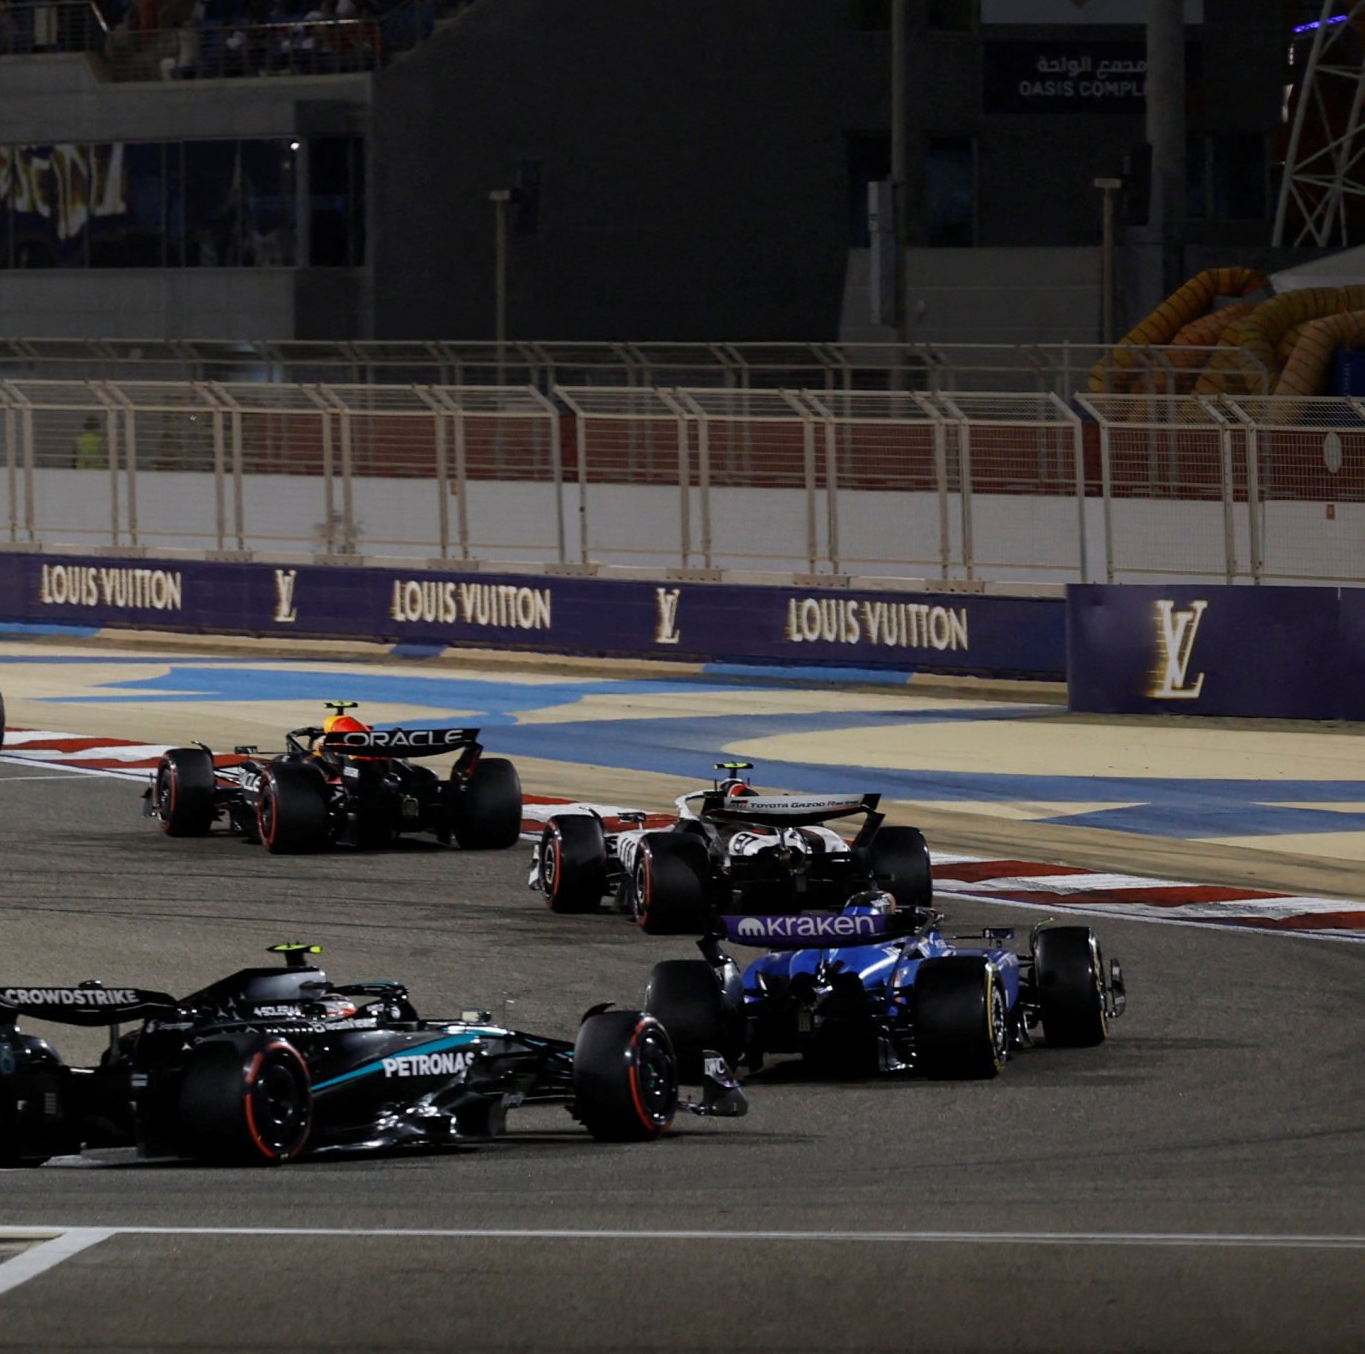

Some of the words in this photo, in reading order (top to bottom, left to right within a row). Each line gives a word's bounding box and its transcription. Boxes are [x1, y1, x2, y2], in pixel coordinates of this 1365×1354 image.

[1018, 80, 1075, 97] OASIS
[1078, 80, 1147, 97] COMPL
[41, 564, 98, 607] LOUIS
[100, 568, 182, 611] VUITTON
[392, 580, 456, 624] LOUIS
[460, 583, 551, 630] VUITTON
[788, 598, 860, 644] LOUIS
[865, 601, 968, 651] VUITTON
[343, 729, 465, 747] ORACLE
[767, 913, 875, 936] kraken
[4, 989, 140, 1005] CROWDSTRIKE
[381, 1051, 475, 1078] PETRONAS
